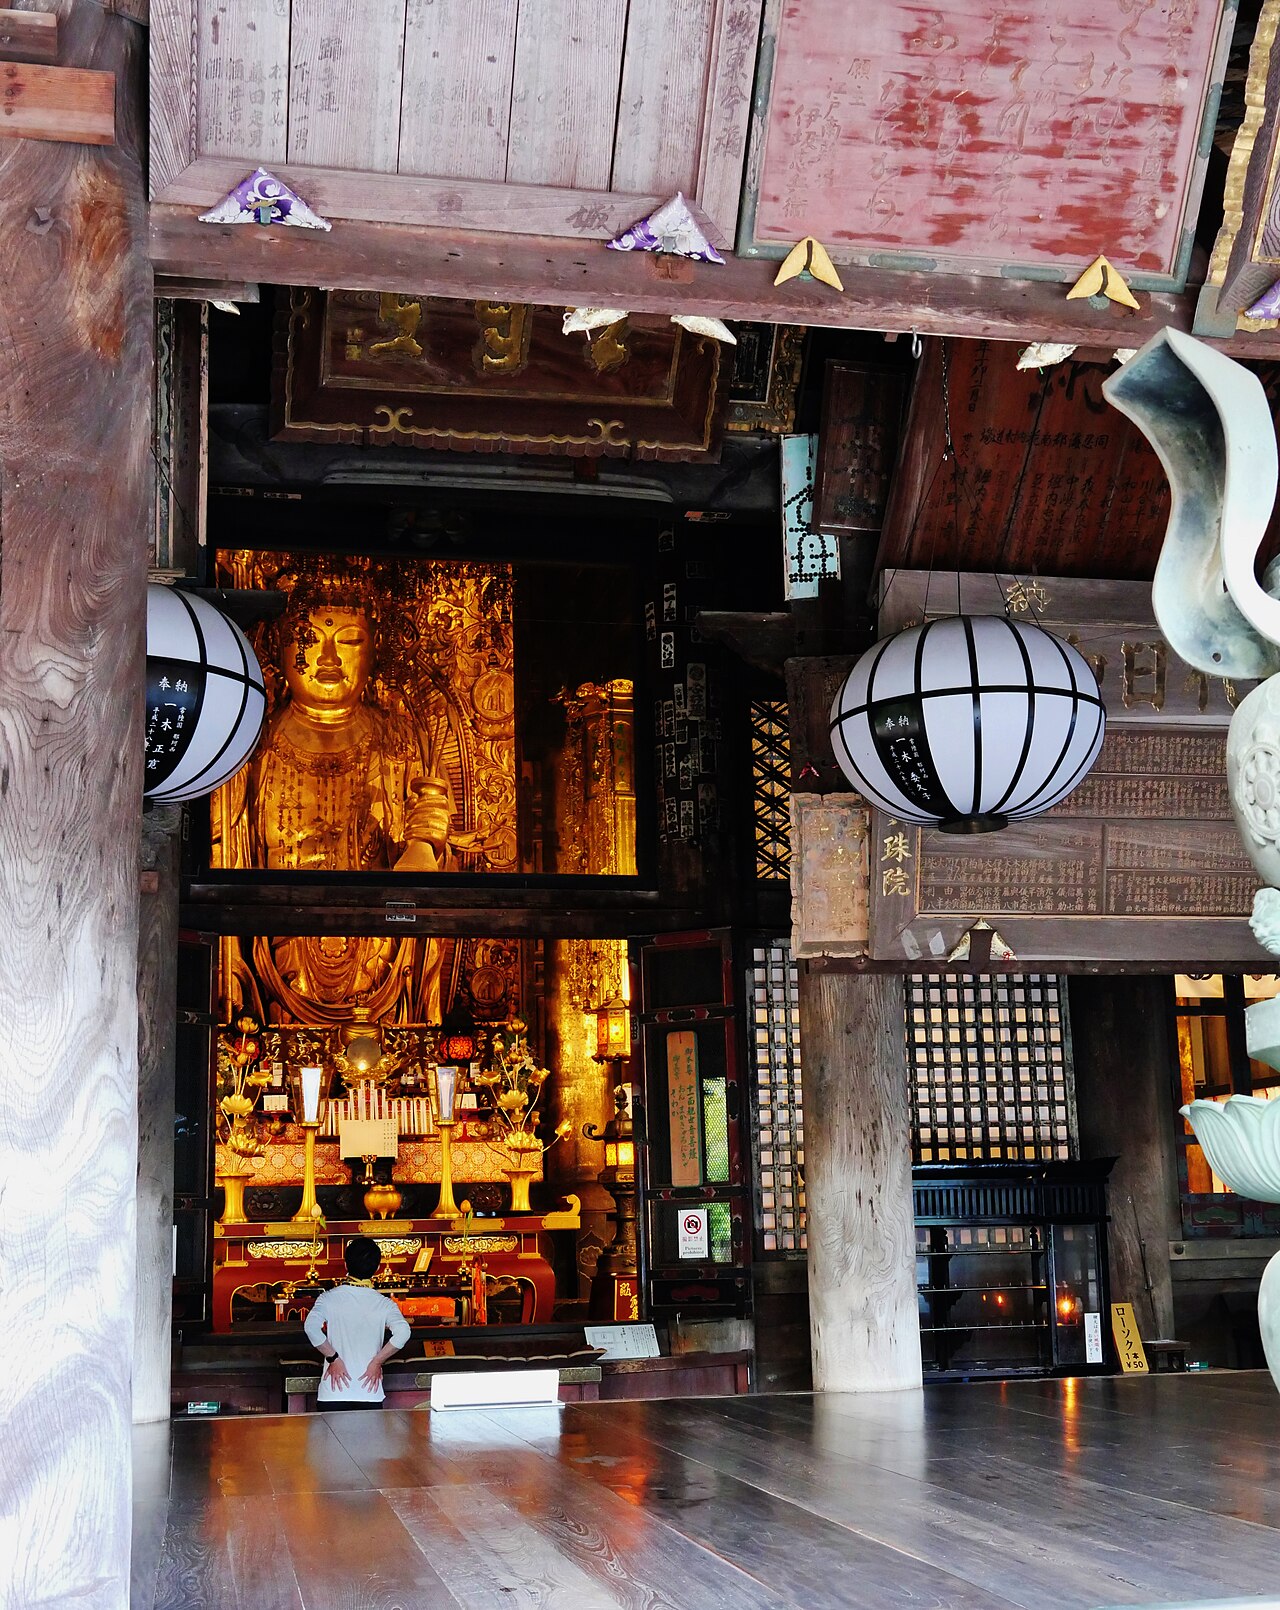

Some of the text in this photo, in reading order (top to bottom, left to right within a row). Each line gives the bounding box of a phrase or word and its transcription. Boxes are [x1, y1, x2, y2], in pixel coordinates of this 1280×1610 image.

[158, 676, 188, 693] 奉納
[885, 715, 910, 731] 奉納
[880, 819, 913, 897] 珠院
[1115, 1307, 1134, 1351] ローソク
